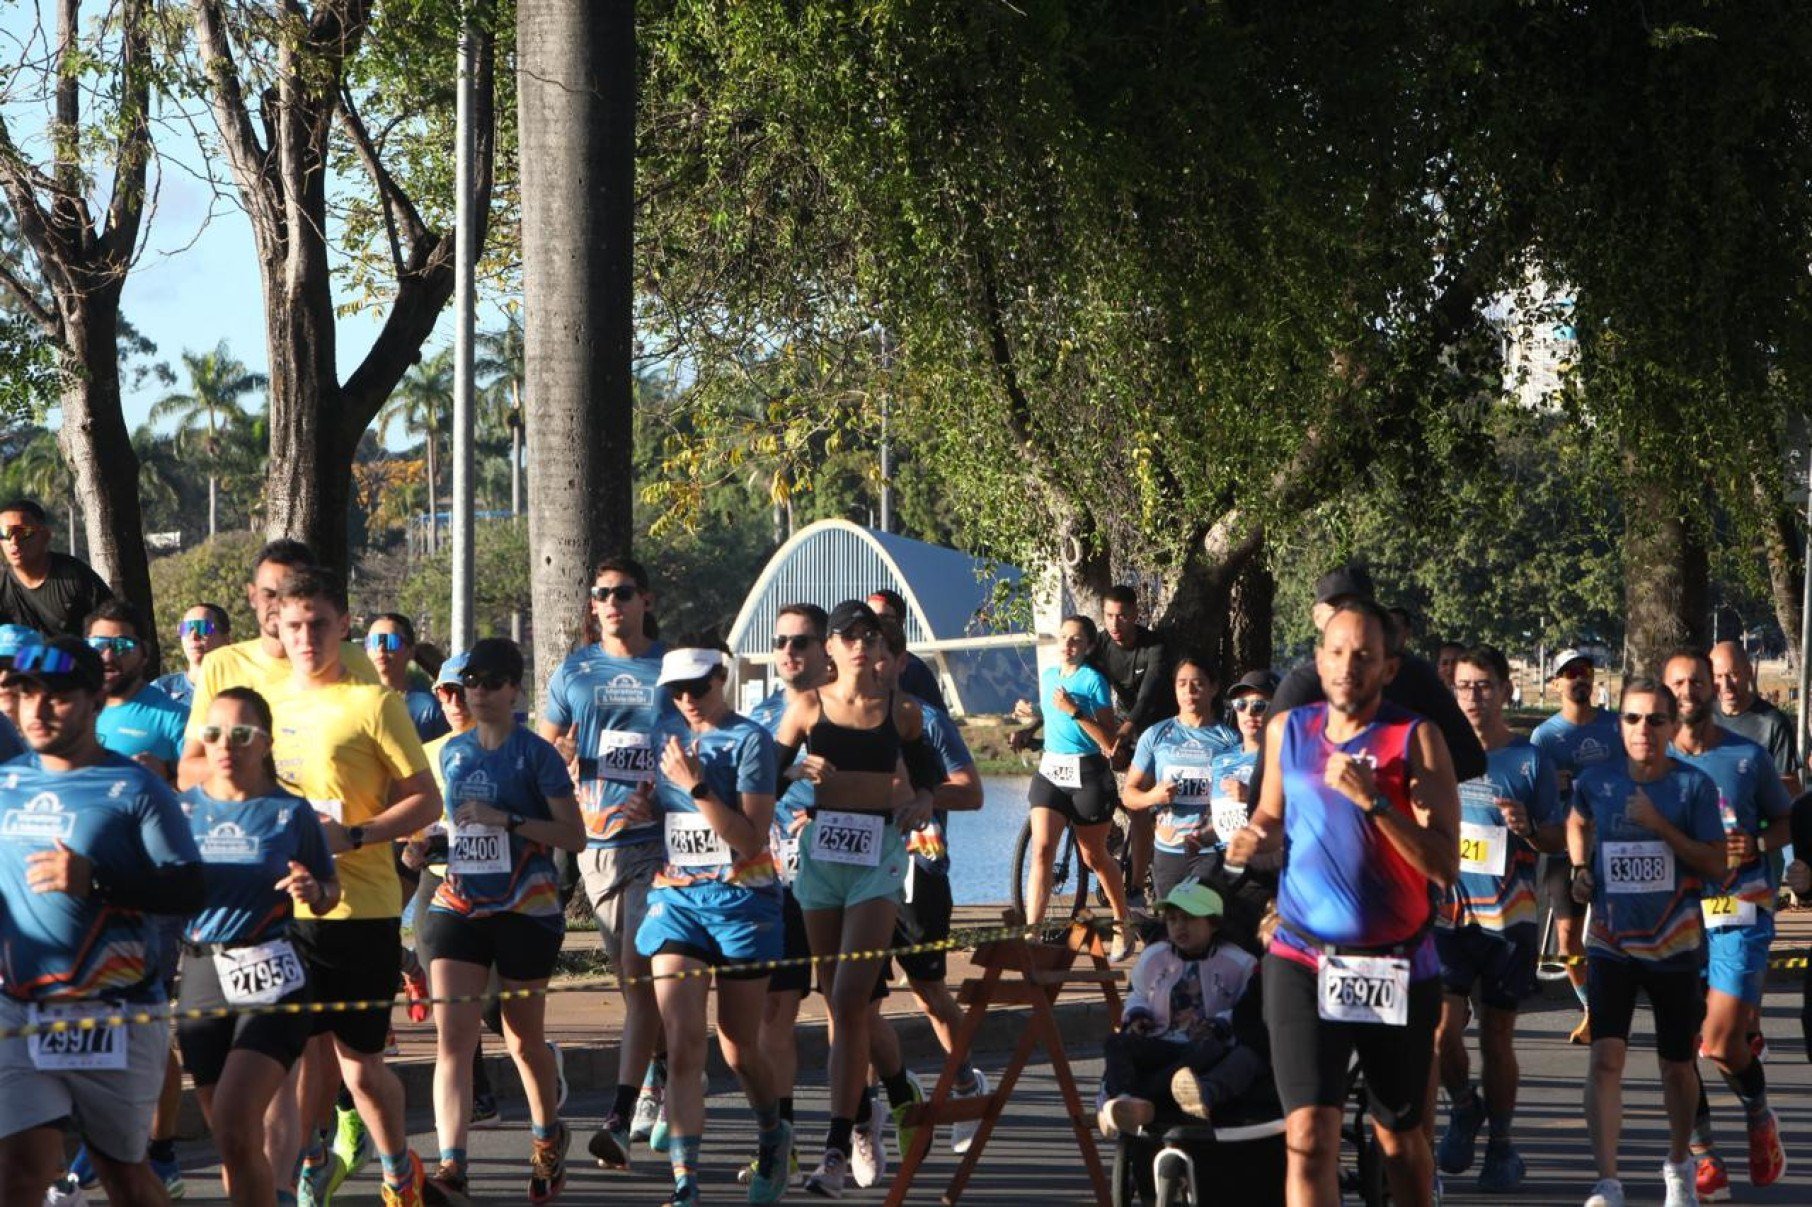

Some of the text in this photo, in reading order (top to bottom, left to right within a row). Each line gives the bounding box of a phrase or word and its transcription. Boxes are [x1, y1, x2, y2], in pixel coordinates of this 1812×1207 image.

[1175, 778, 1208, 796] 9179
[455, 837, 499, 860] 29400
[670, 830, 717, 853] 28134
[820, 827, 872, 853] 25276
[1460, 838, 1480, 861] 21
[1610, 857, 1664, 881] 33088
[1712, 896, 1731, 915] 22
[230, 955, 298, 997] 27956
[1327, 976, 1394, 1009] 26970
[40, 1024, 113, 1054] 29977
